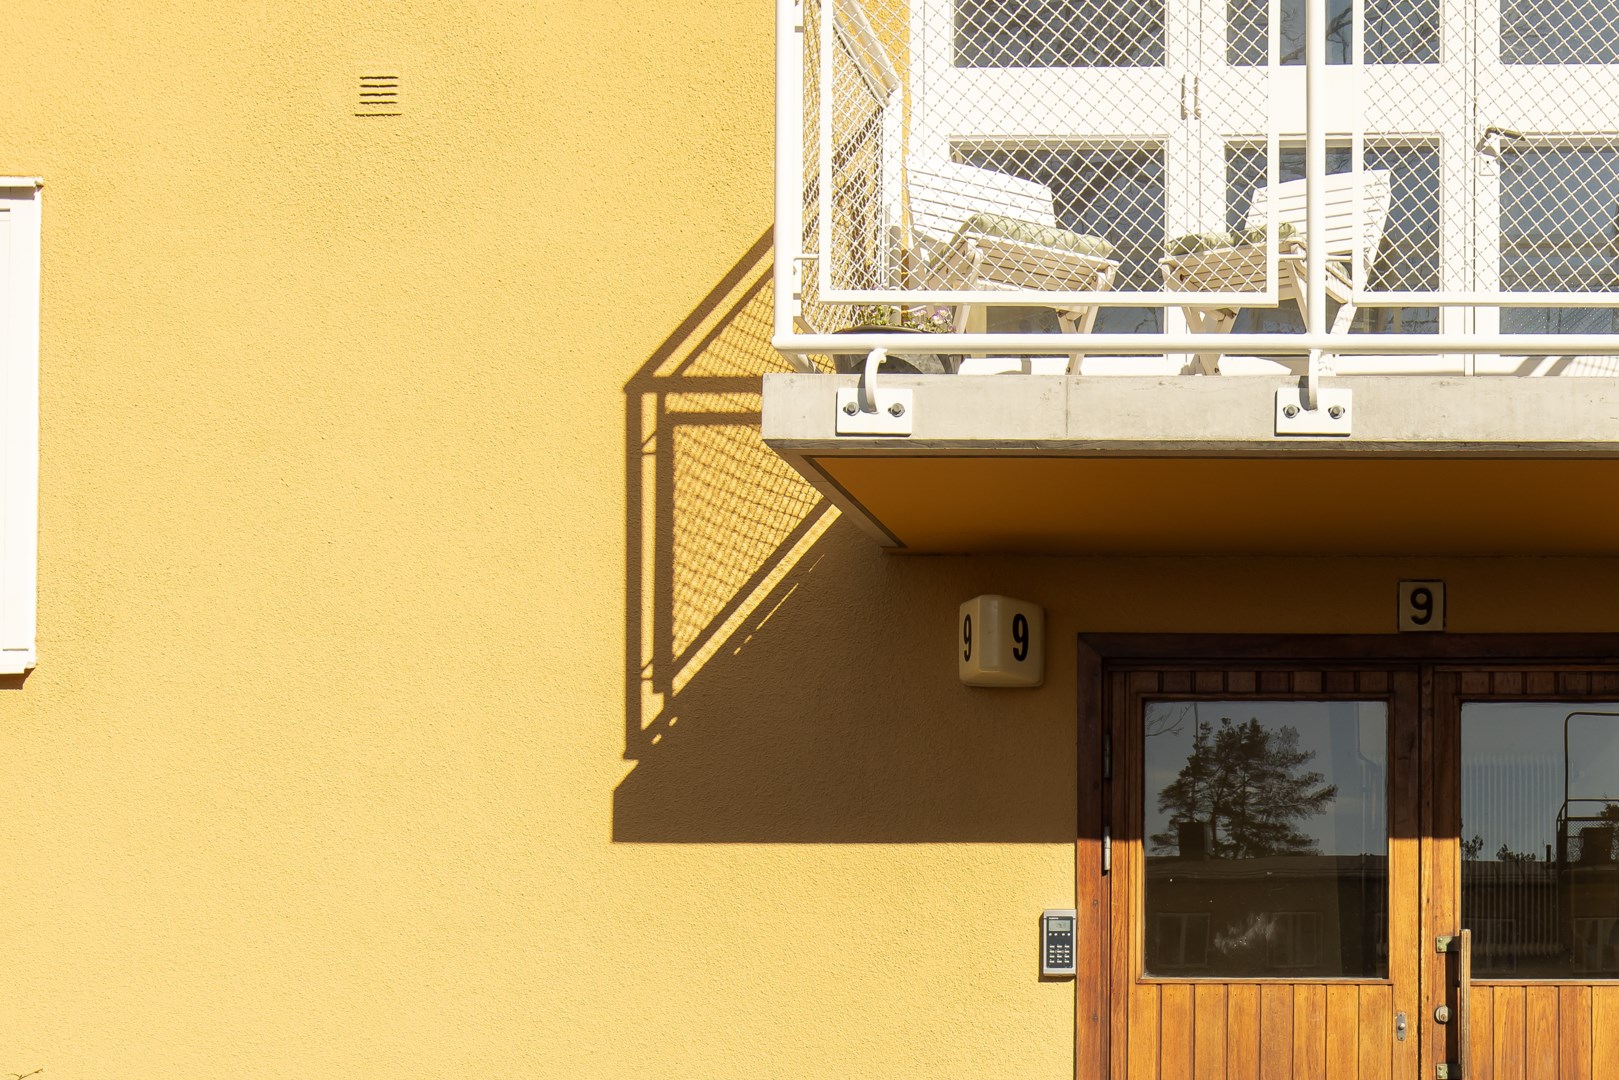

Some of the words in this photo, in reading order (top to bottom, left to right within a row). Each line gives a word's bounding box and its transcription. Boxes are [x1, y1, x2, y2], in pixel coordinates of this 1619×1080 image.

[1410, 588, 1433, 625] 9
[963, 614, 972, 662] 9
[1012, 613, 1029, 662] 9
